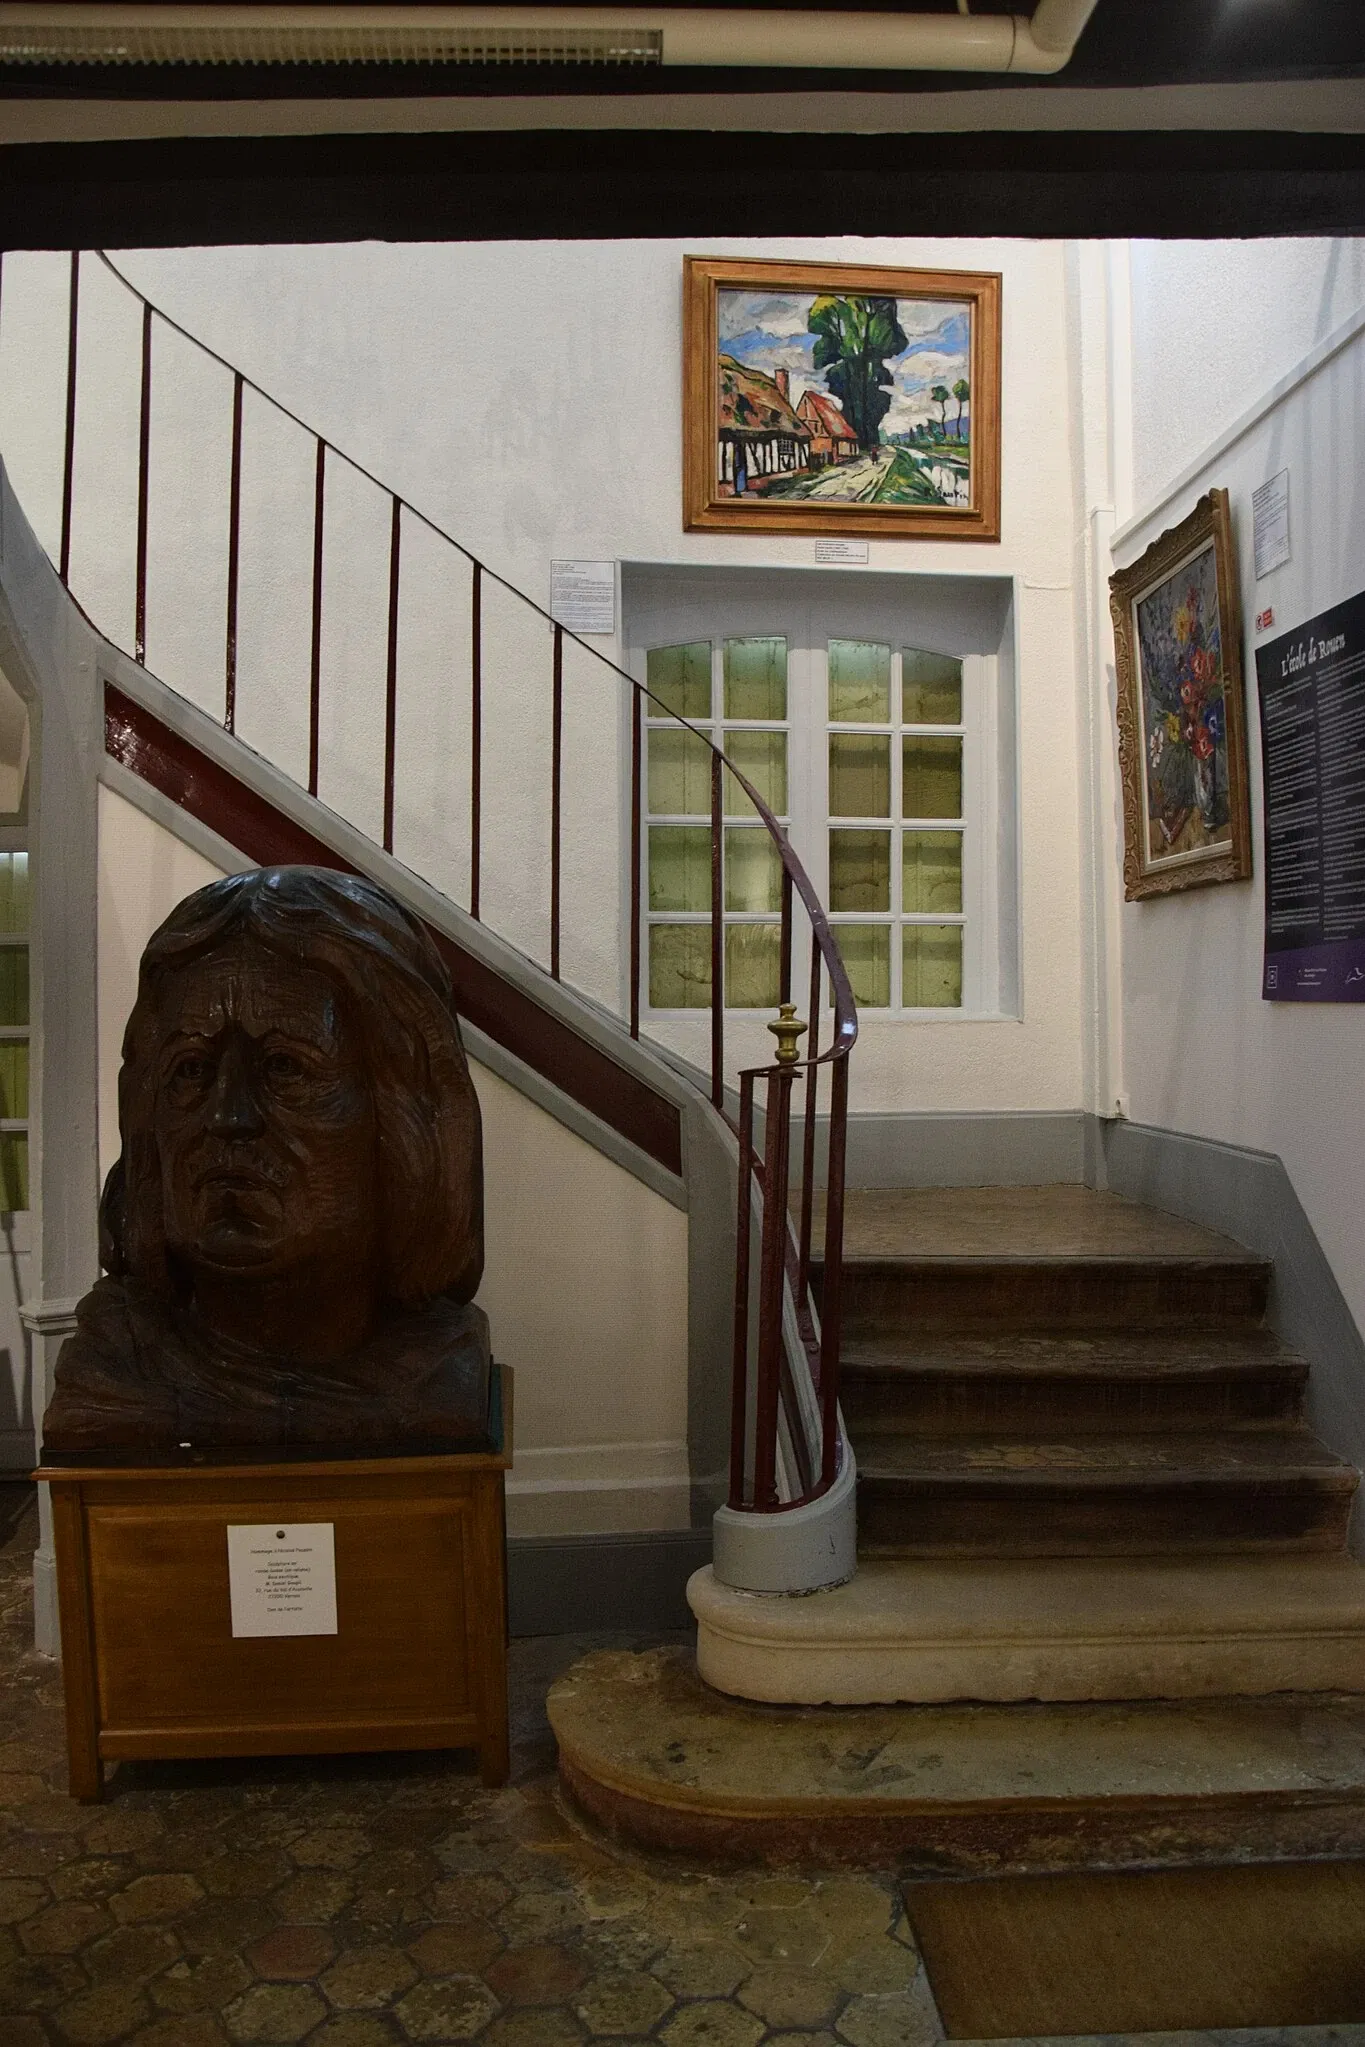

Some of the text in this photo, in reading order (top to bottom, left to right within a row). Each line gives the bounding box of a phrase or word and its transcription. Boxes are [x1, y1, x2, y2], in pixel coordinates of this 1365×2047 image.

[1281, 633, 1346, 677] L'école de Rouen
